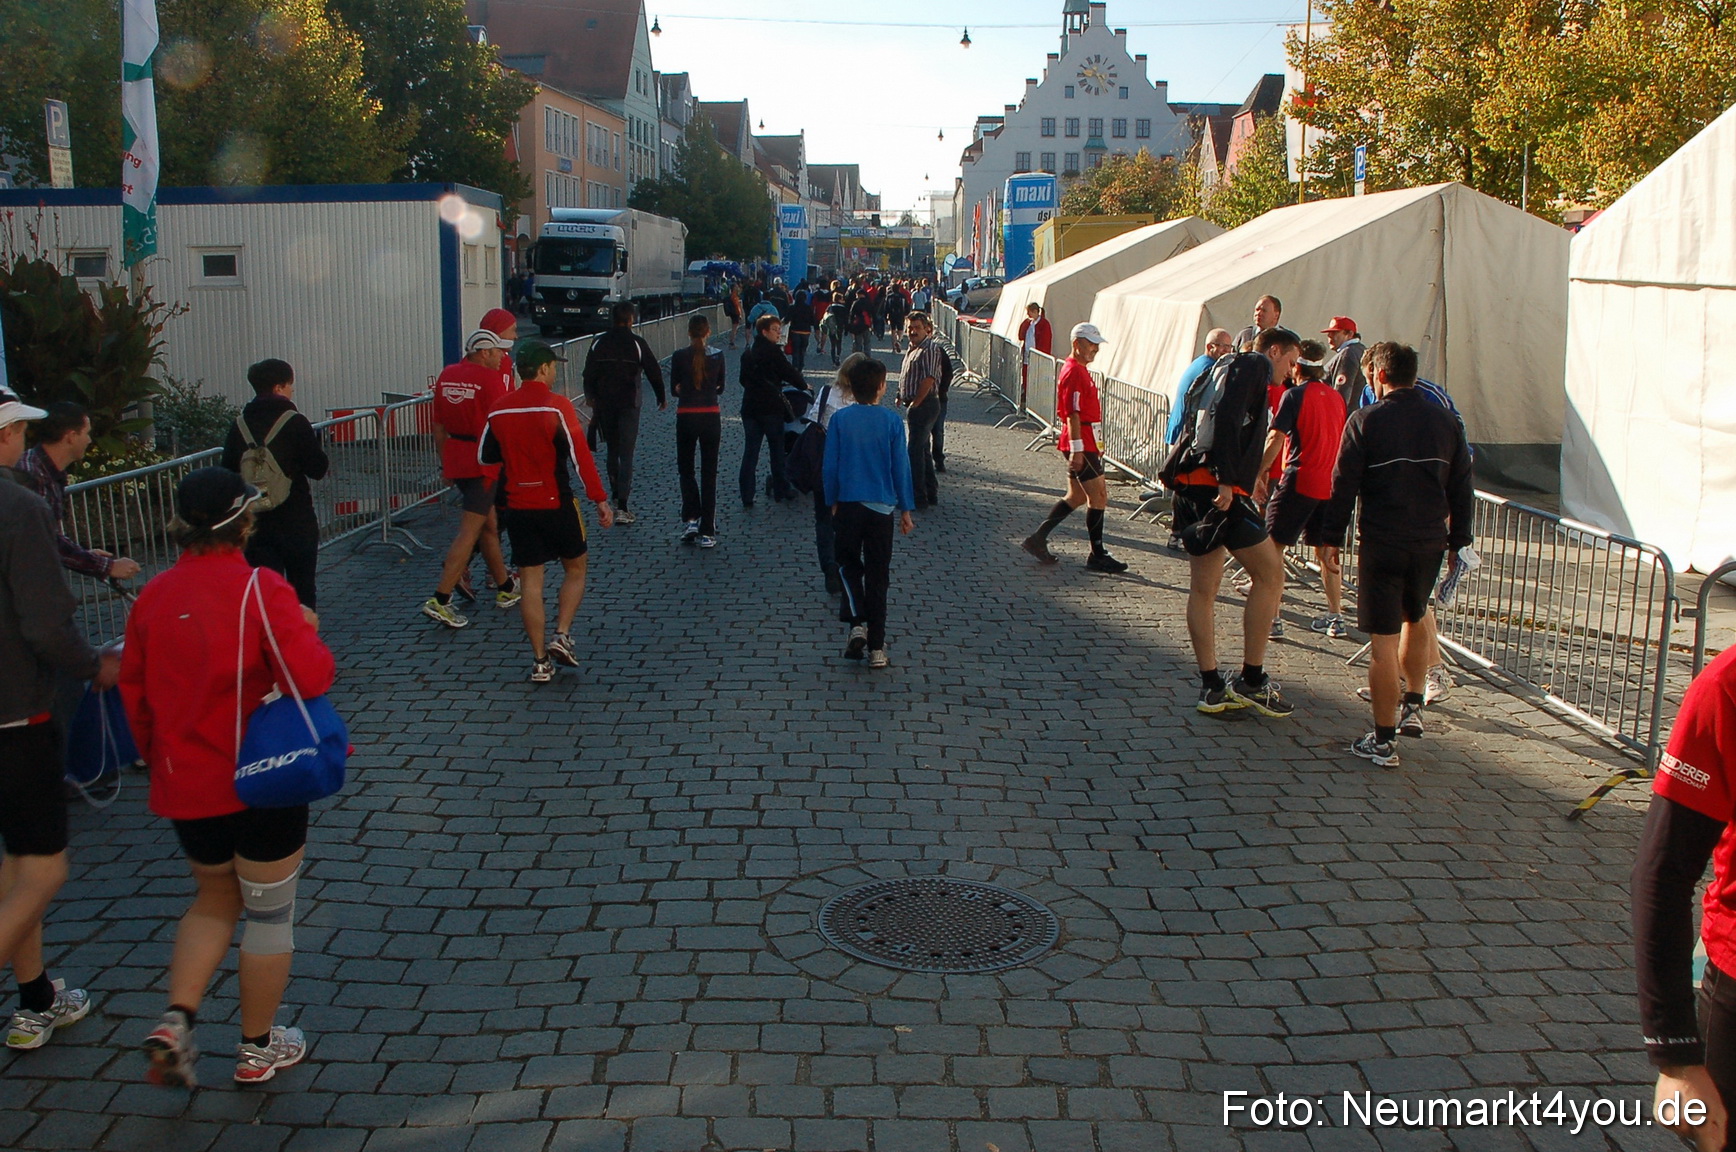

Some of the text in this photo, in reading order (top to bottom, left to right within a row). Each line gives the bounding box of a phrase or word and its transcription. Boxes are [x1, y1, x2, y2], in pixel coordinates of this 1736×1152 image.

[51, 106, 63, 140] P
[1015, 183, 1051, 202] maxi
[1037, 210, 1051, 221] dsl
[788, 229, 799, 238] dsl
